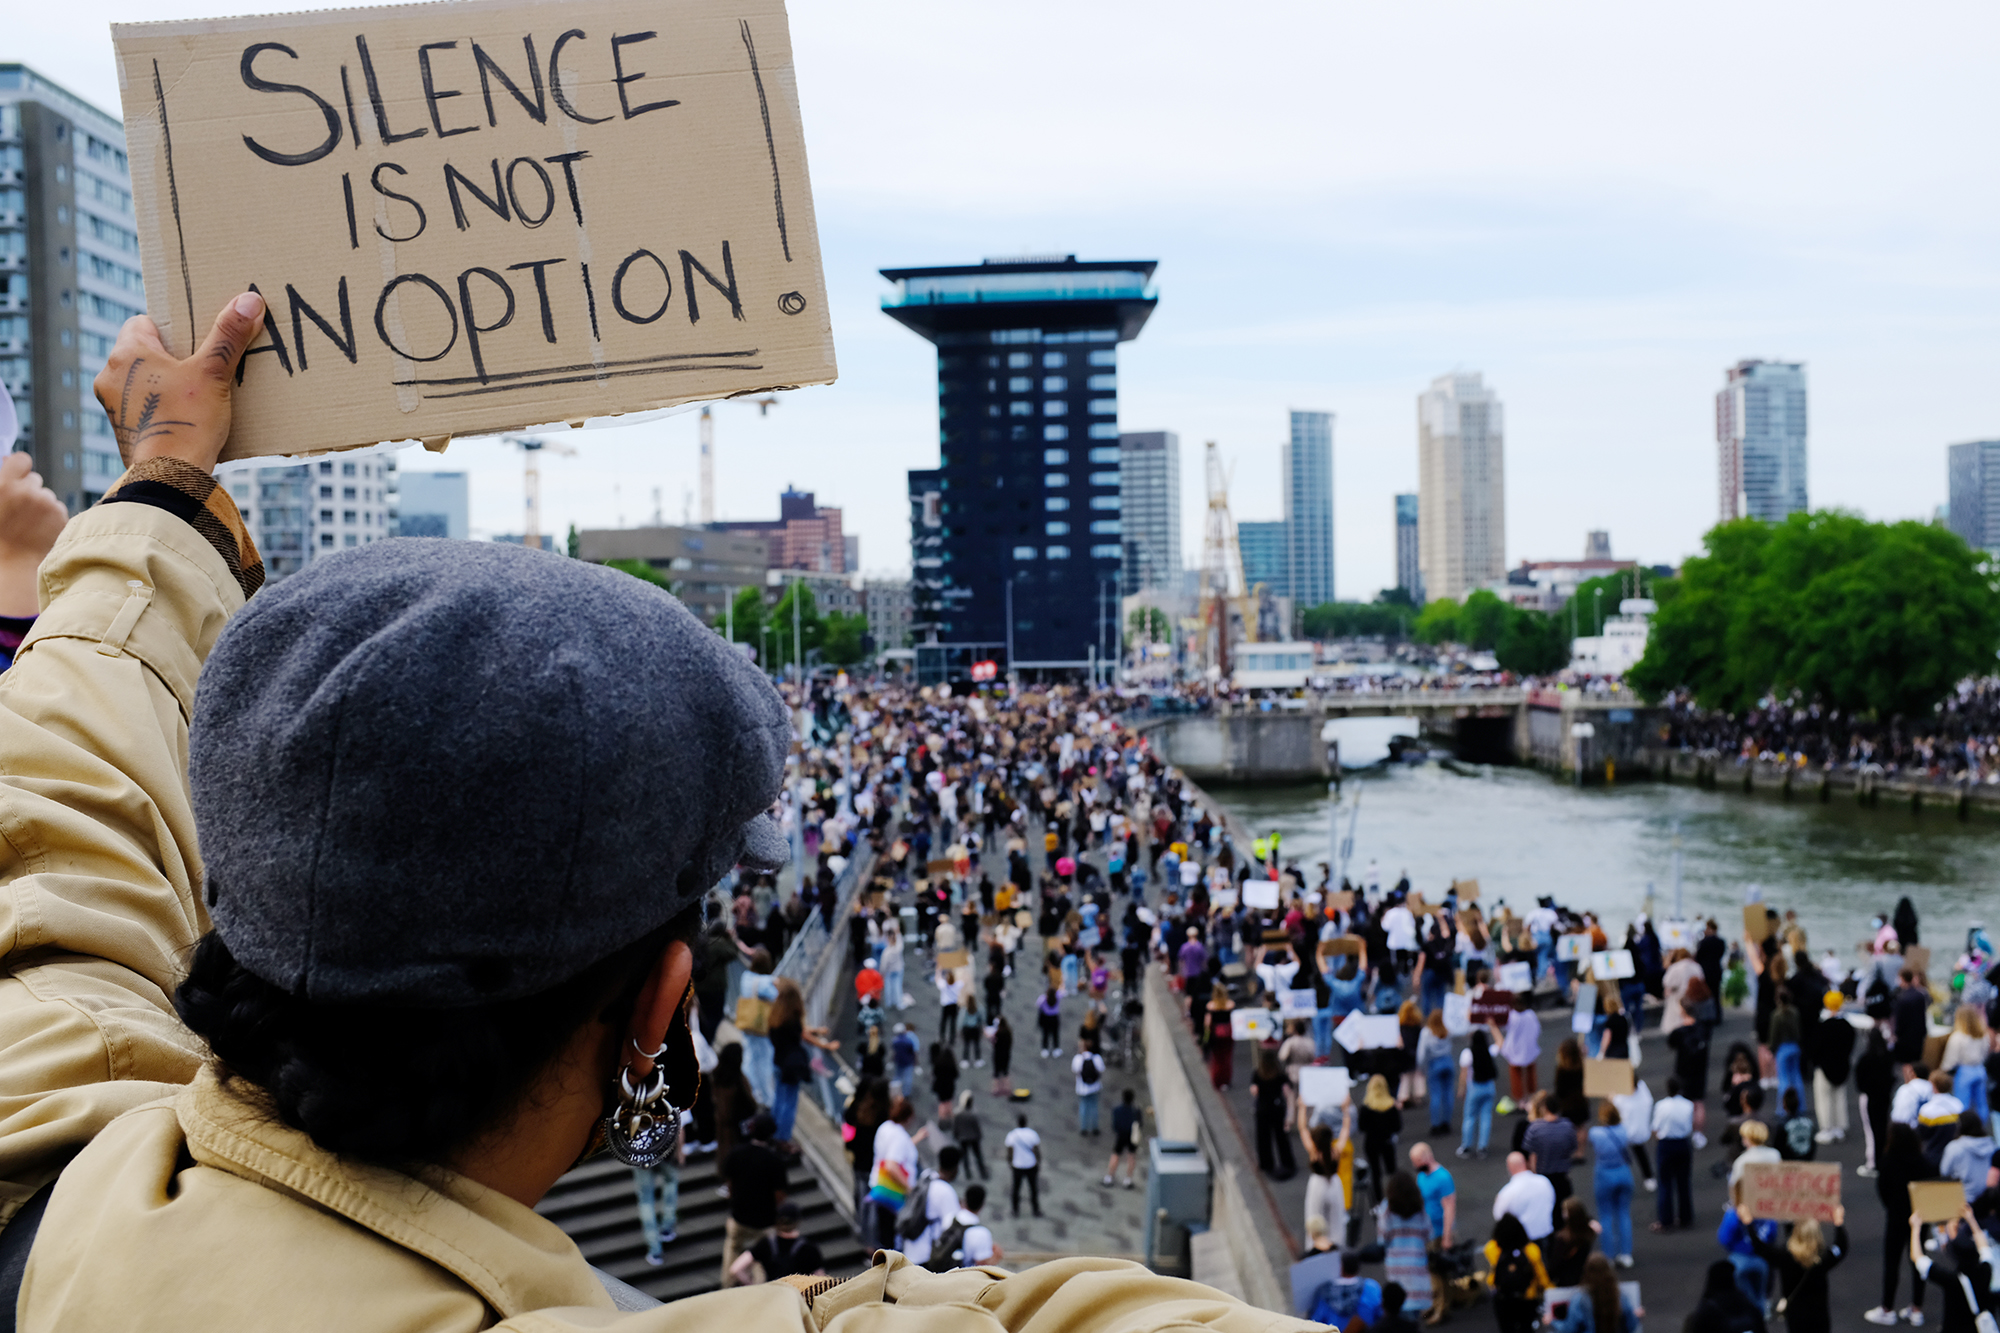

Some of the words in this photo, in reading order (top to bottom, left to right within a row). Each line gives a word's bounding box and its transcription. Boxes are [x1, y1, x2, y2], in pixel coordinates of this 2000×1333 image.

[240, 29, 681, 166] SILENCE
[341, 162, 427, 250] IS
[444, 150, 592, 232] NOT
[235, 275, 357, 387] AN
